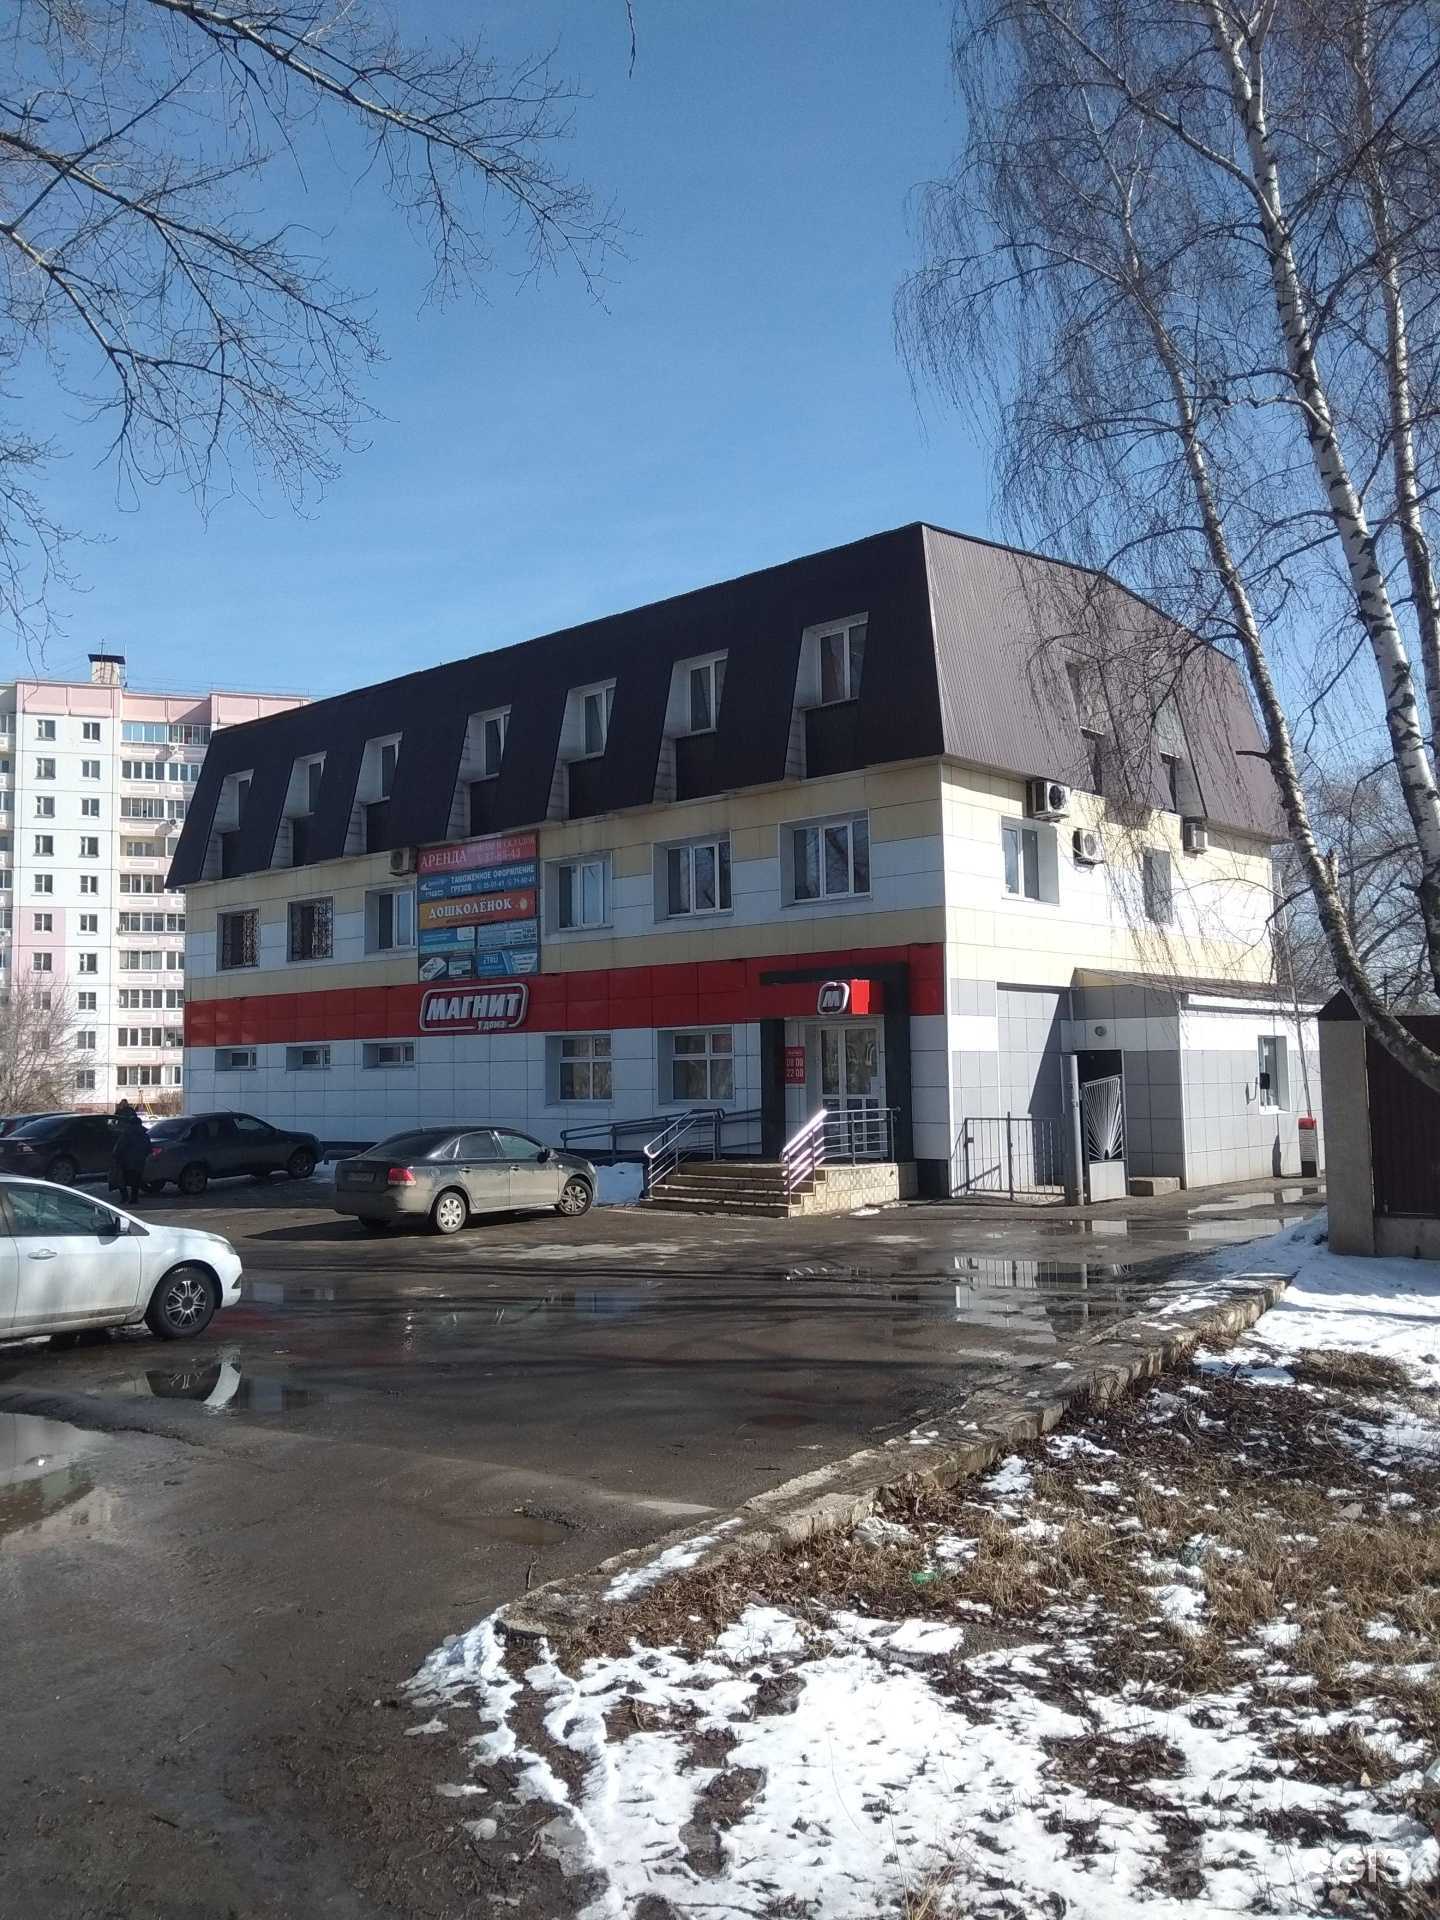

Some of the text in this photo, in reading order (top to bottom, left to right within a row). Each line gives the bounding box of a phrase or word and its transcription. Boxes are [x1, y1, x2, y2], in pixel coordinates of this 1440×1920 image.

[421, 849, 466, 868] АРЕНДА
[451, 864, 535, 884] ТАМОЖЕННОЕ ОФОРМЛЕНИЕ
[428, 896, 513, 919] ДОШКОЛЁНОК
[426, 993, 521, 1021] МАГНИТ
